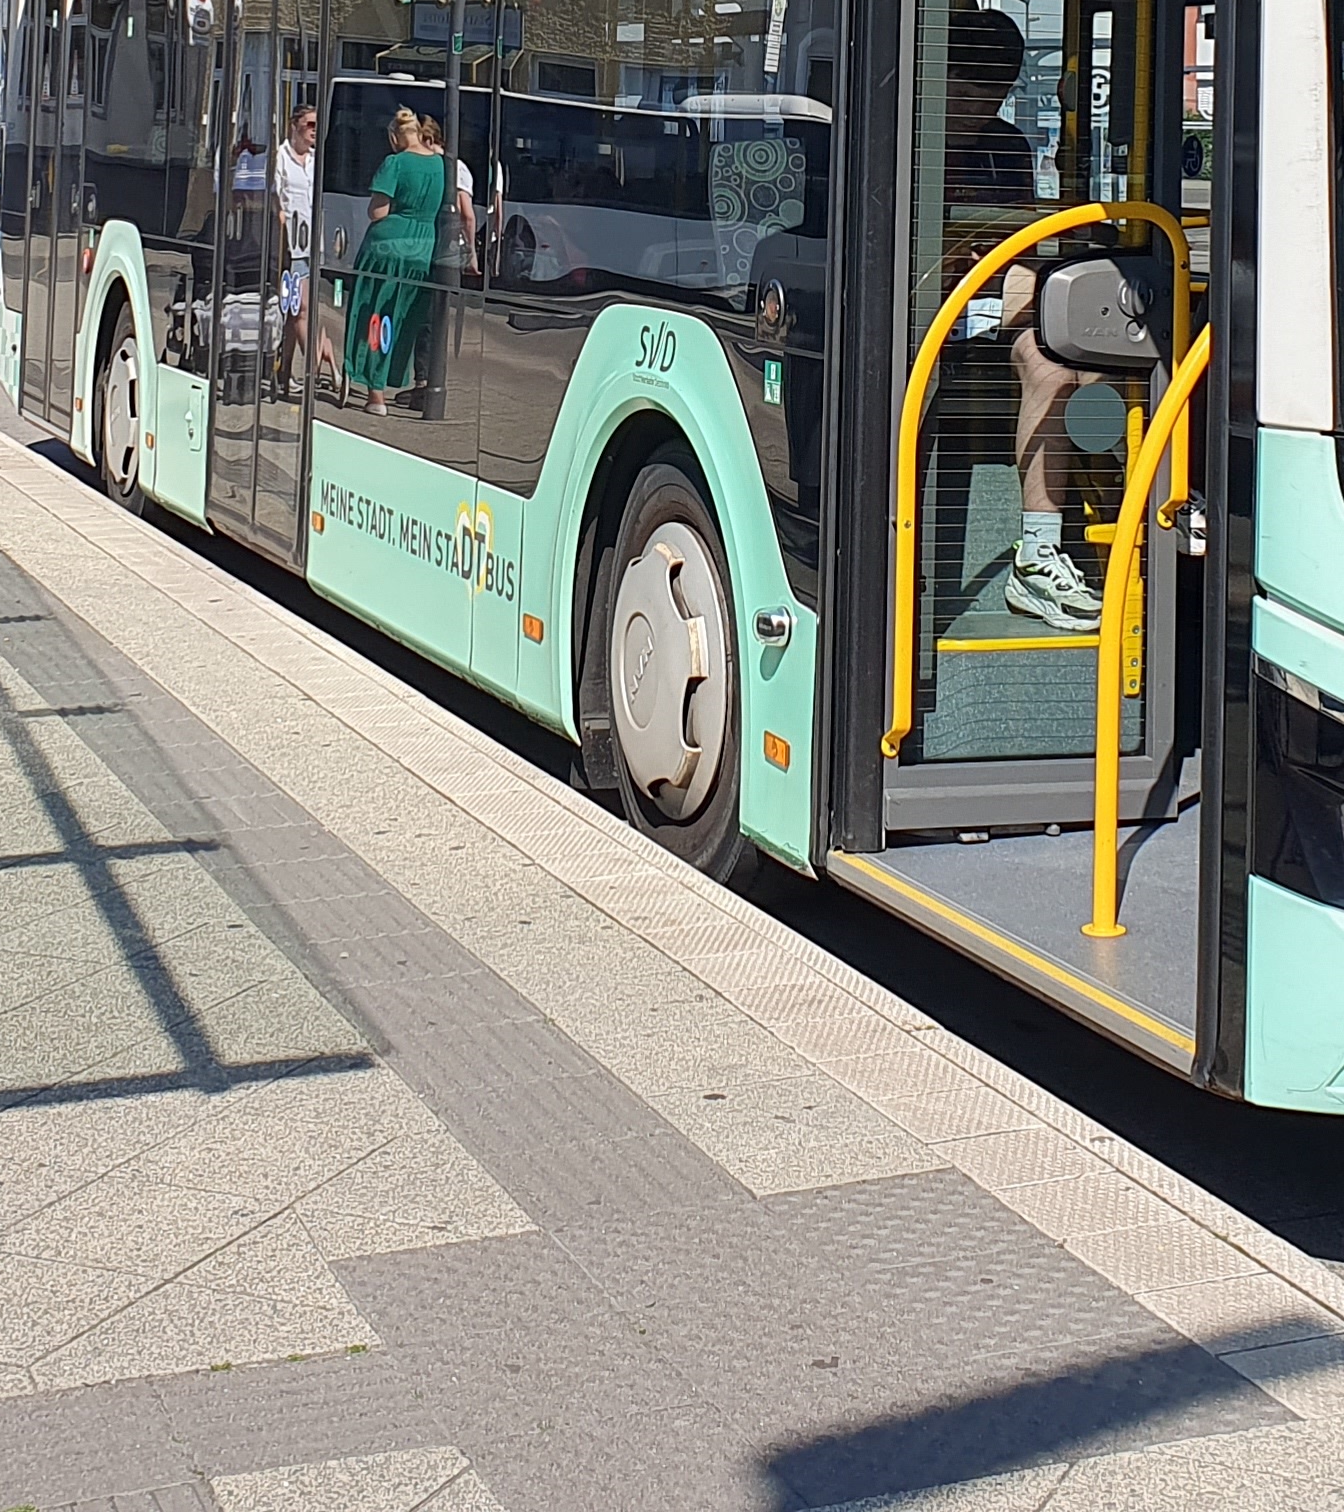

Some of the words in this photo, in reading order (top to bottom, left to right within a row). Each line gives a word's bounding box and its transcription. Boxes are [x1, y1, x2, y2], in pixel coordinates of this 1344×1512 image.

[635, 321, 676, 372] SVD
[321, 478, 355, 525] MEINE
[357, 495, 396, 546] STADT.
[399, 513, 432, 563] MEIN
[435, 525, 516, 602] STADTBUS
